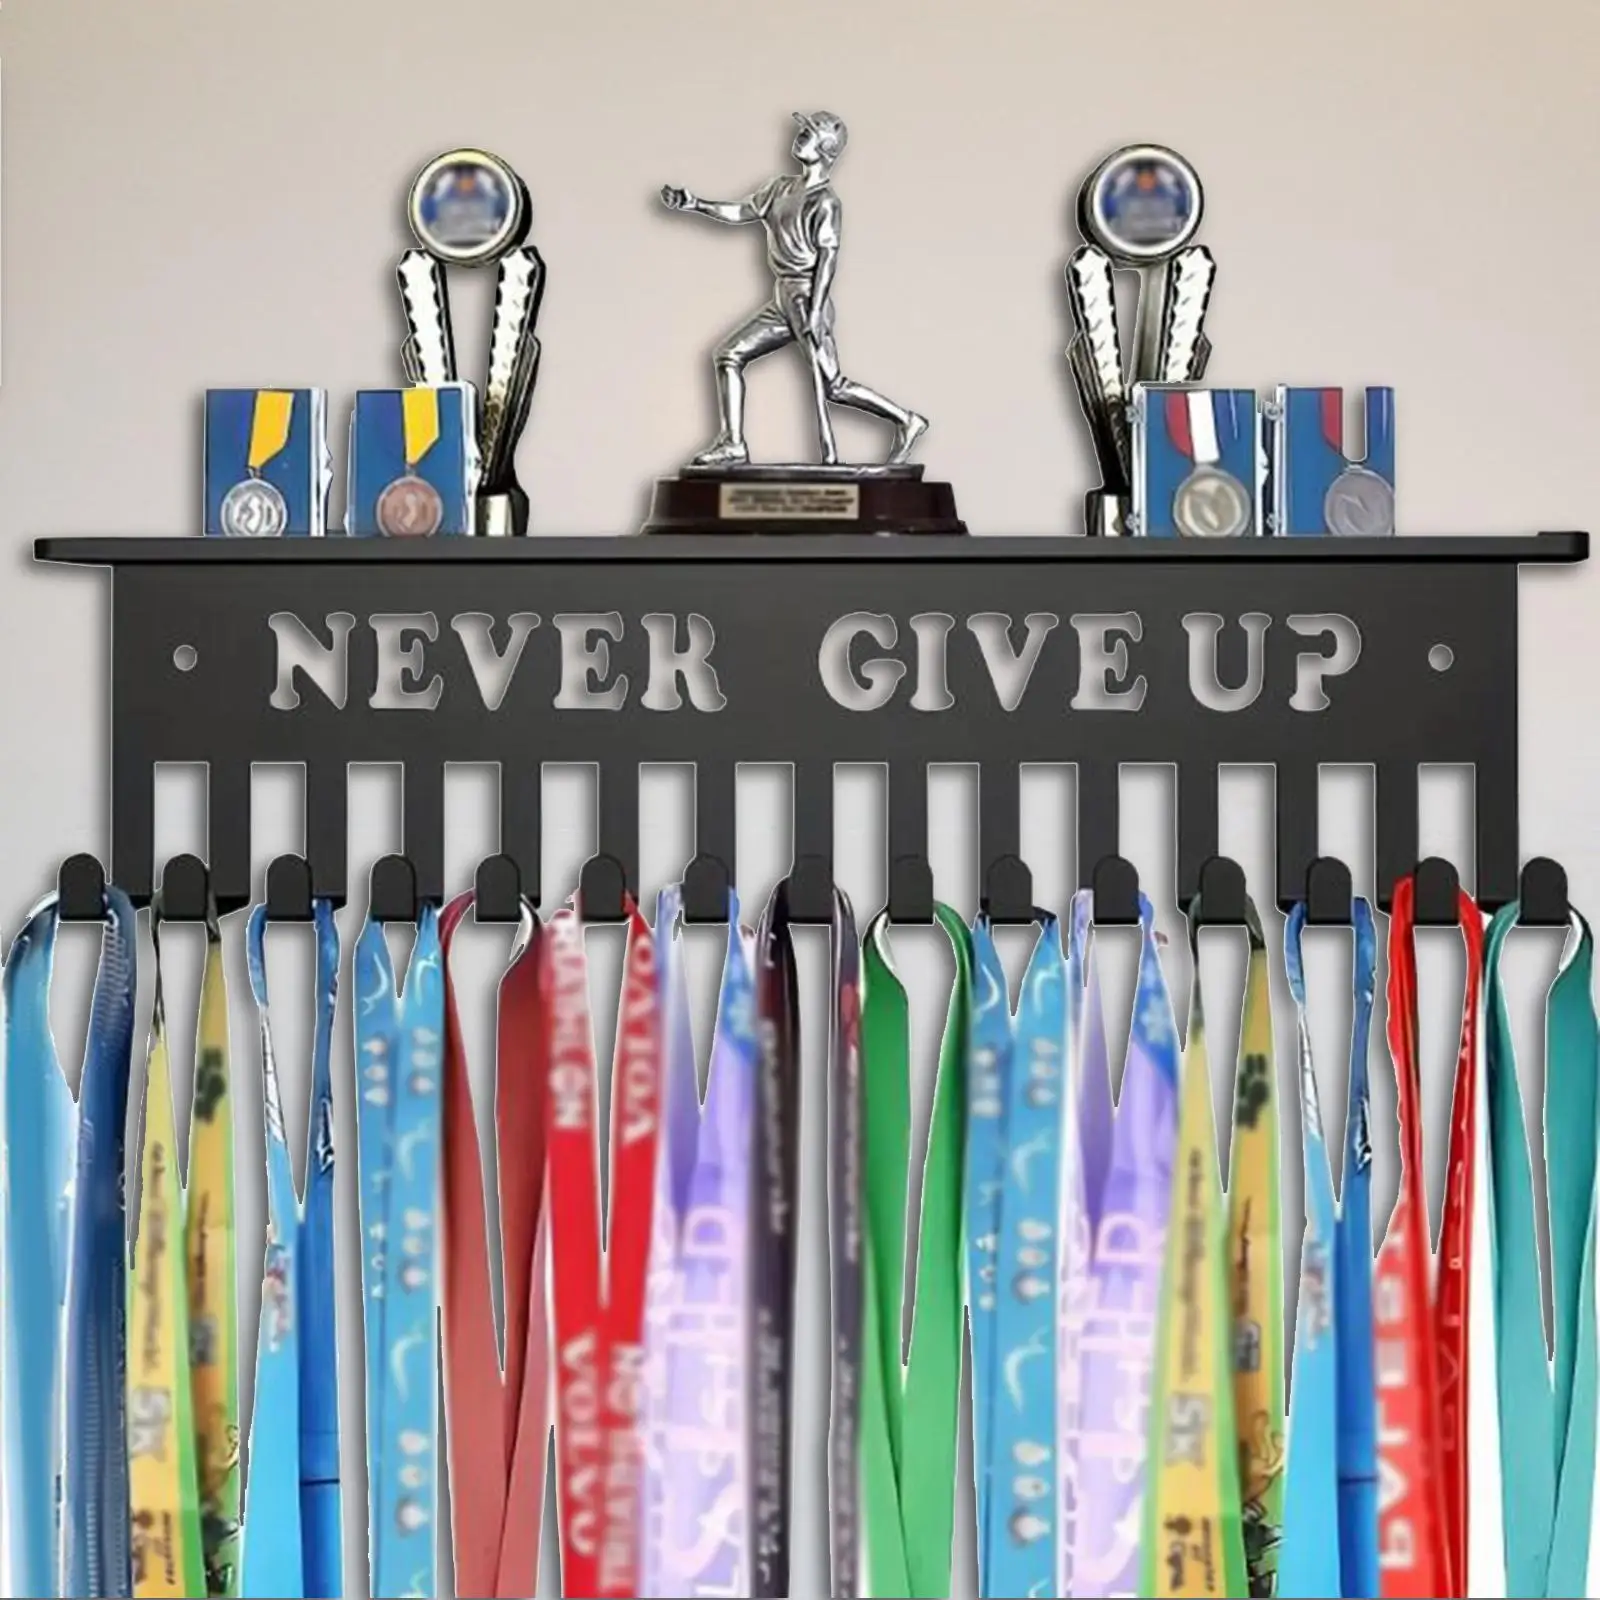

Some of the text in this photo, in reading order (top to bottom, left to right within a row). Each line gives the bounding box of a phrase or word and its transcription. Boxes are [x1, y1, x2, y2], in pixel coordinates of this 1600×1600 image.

[268, 611, 1362, 712] NEVER GIVE UP
